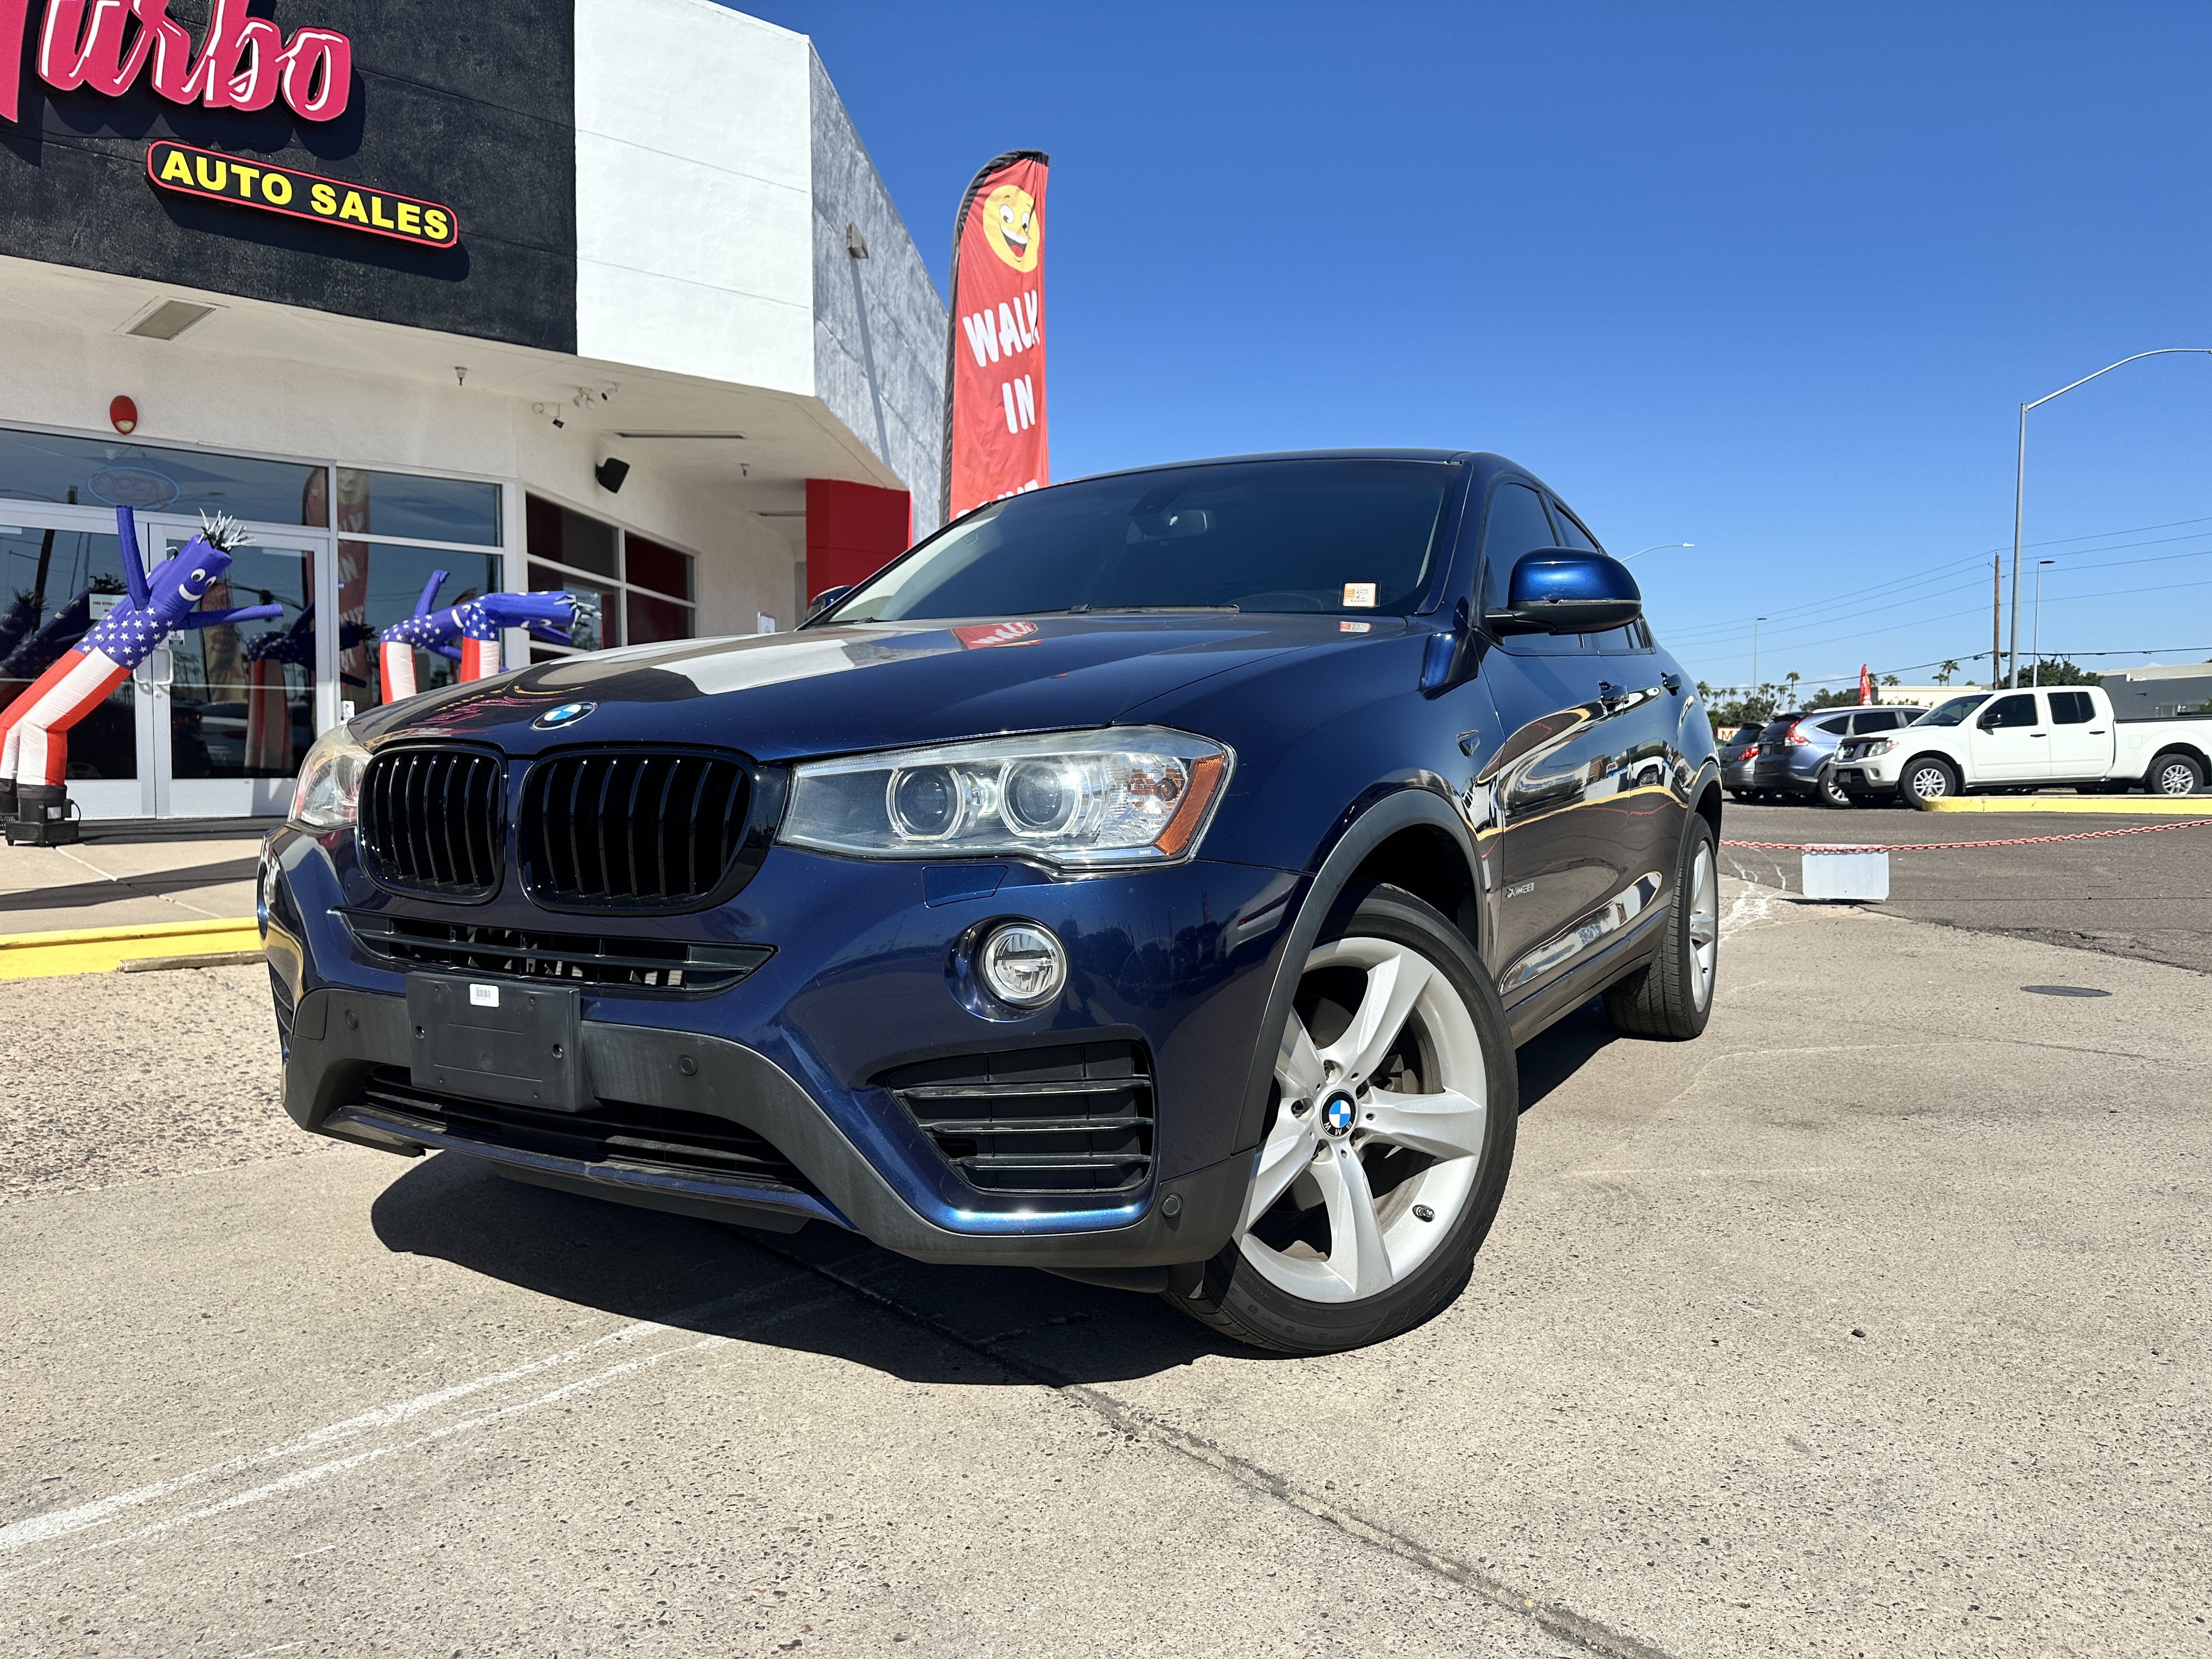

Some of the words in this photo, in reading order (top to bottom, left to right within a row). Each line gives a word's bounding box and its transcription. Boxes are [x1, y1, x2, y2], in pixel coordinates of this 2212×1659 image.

[0, 0, 351, 122] urbo
[160, 150, 293, 205] AUTO
[311, 183, 449, 241] SALES
[962, 289, 1041, 368] WALK
[1002, 374, 1036, 434] IN
[1324, 1121, 1352, 1135] BMW
